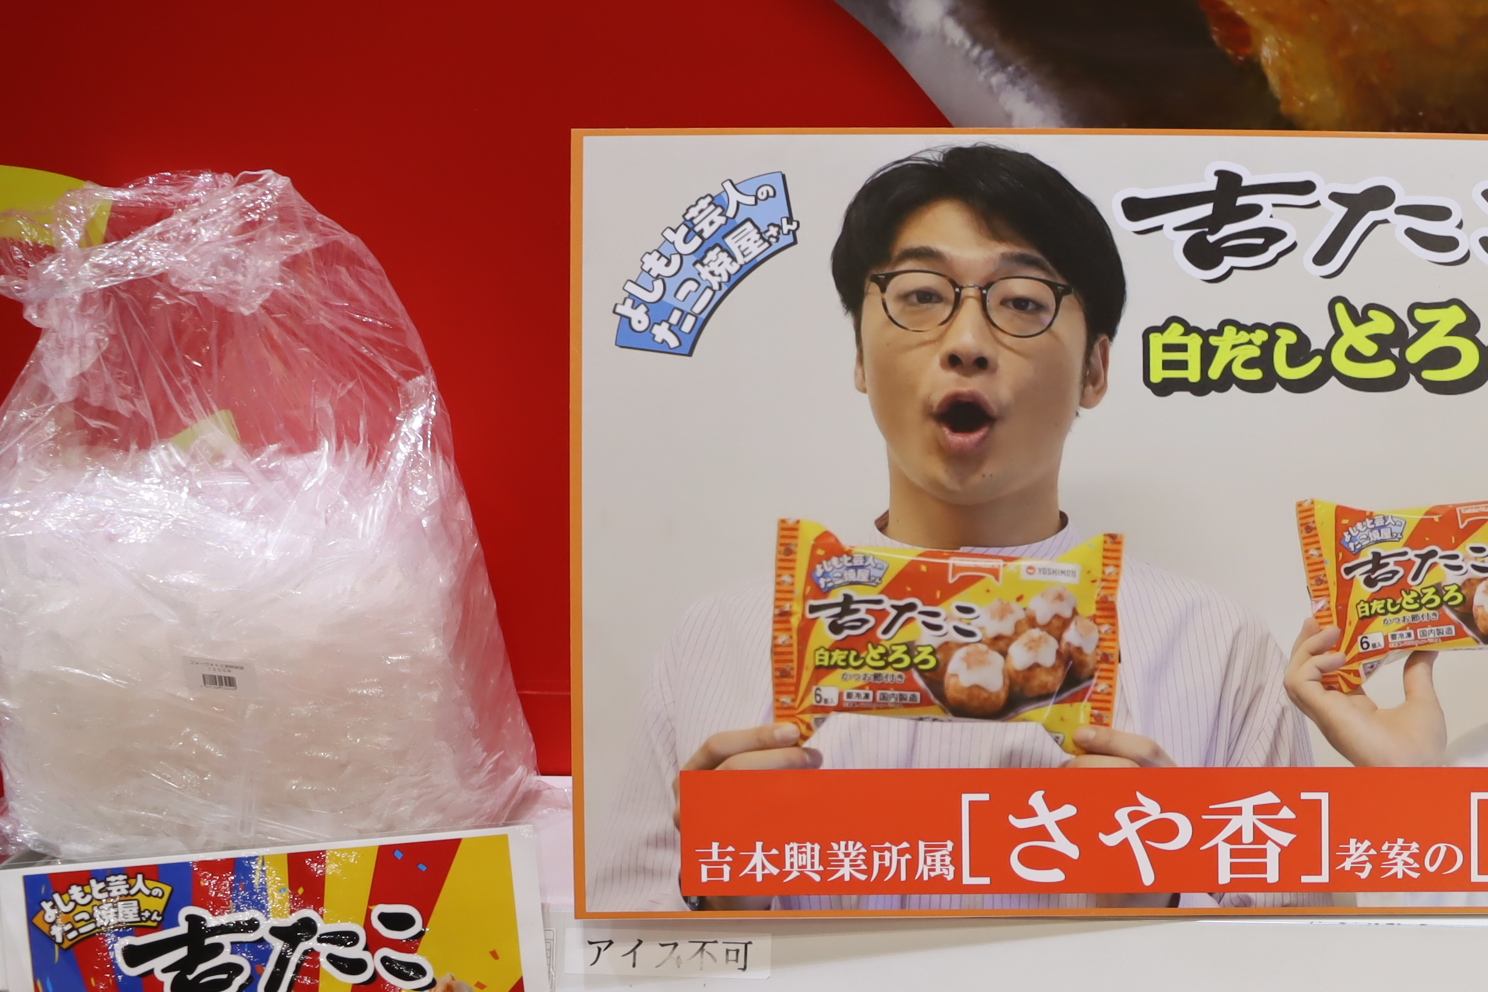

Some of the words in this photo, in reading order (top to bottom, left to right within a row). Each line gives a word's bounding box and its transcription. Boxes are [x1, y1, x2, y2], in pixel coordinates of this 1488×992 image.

[613, 178, 777, 333] よしもと芸人の
[651, 216, 799, 350] たこ焼屋さん
[808, 593, 982, 641] 吉たこ
[1357, 584, 1464, 618] 白だしとろろ
[1383, 612, 1440, 626] かつお節付き
[1418, 627, 1454, 638] 国内製造
[815, 644, 939, 670] 白だしとろろ
[38, 873, 164, 928] よしもと芸人の
[50, 901, 163, 946] たこ焼屋さん
[585, 937, 755, 972] アイス不可
